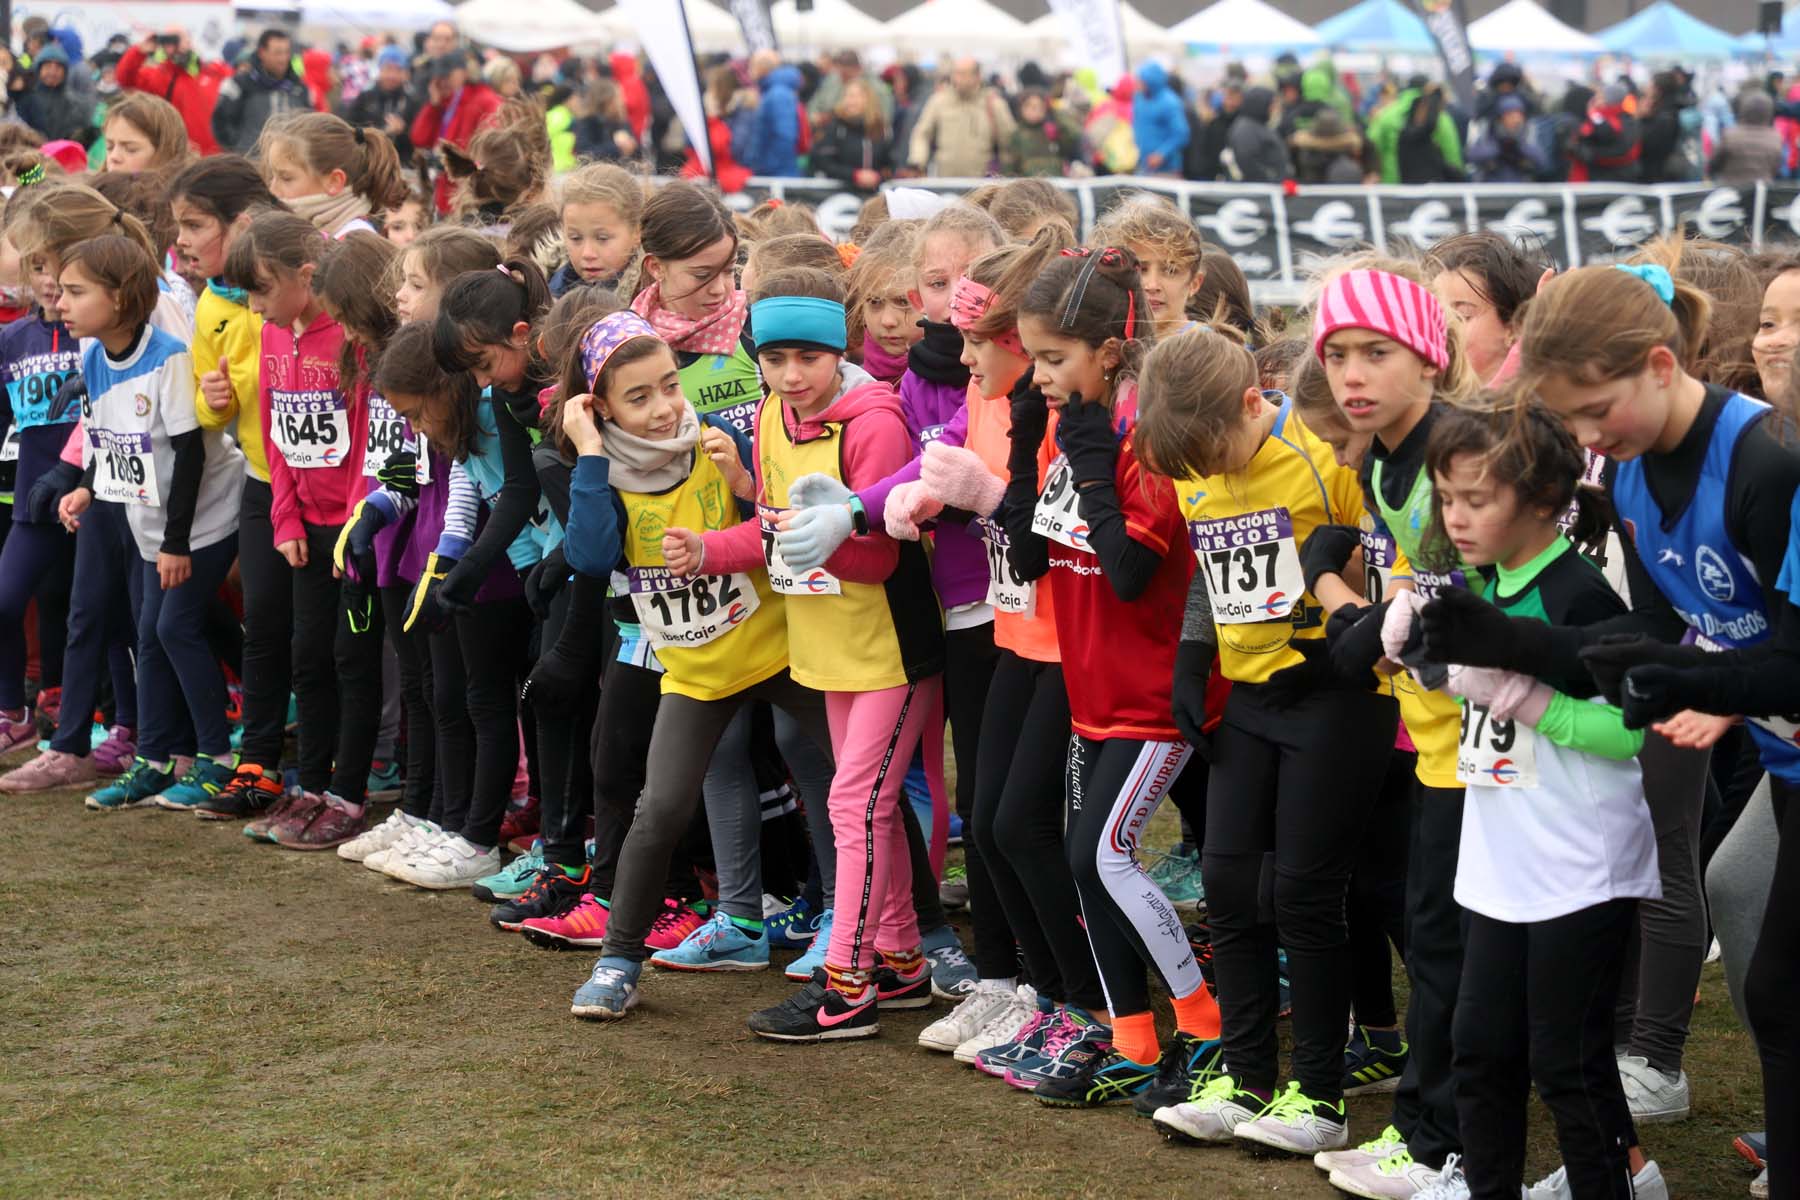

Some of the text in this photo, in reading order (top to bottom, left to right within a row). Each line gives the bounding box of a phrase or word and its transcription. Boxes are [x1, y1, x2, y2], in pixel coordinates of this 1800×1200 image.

[698, 379, 747, 405] HAZA
[277, 413, 338, 447] 1645
[366, 420, 405, 454] 848
[1033, 513, 1064, 532] Caja
[650, 574, 743, 627] 1782
[661, 623, 717, 642] iberCaja
